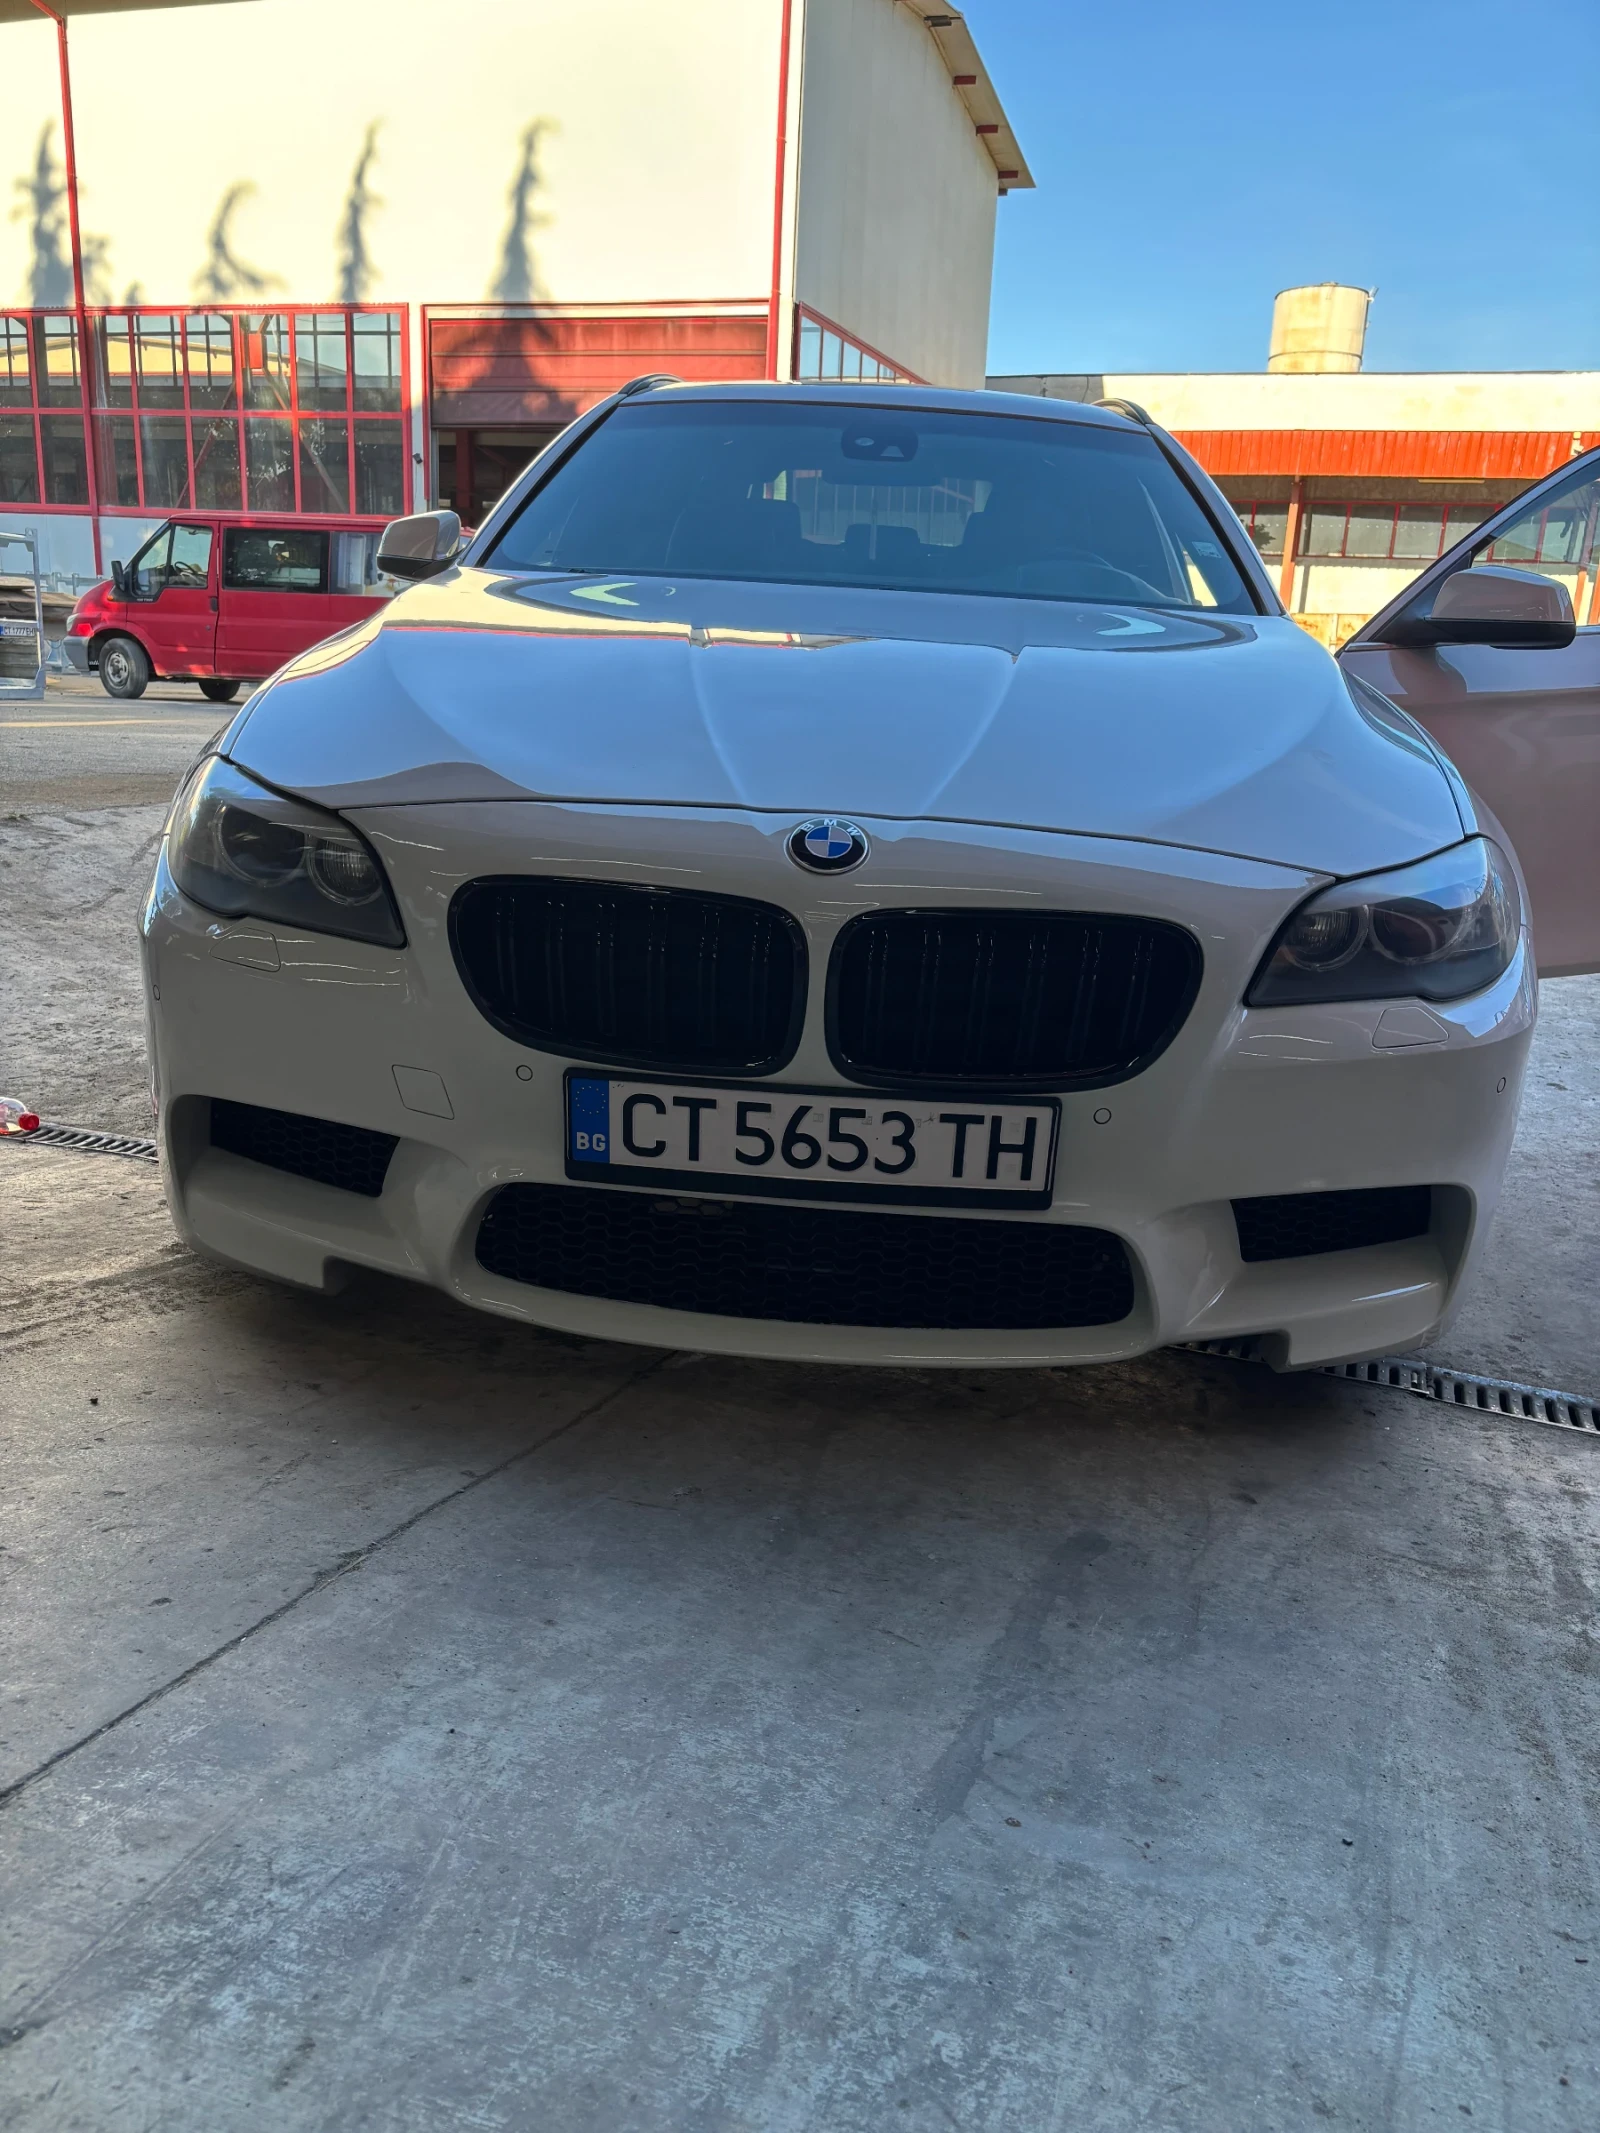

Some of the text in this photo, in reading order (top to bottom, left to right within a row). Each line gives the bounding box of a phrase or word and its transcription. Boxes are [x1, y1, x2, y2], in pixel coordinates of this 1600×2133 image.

[800, 818, 861, 836] BMW
[576, 1132, 606, 1152] BG
[622, 1093, 1038, 1181] CT 5653 TH
